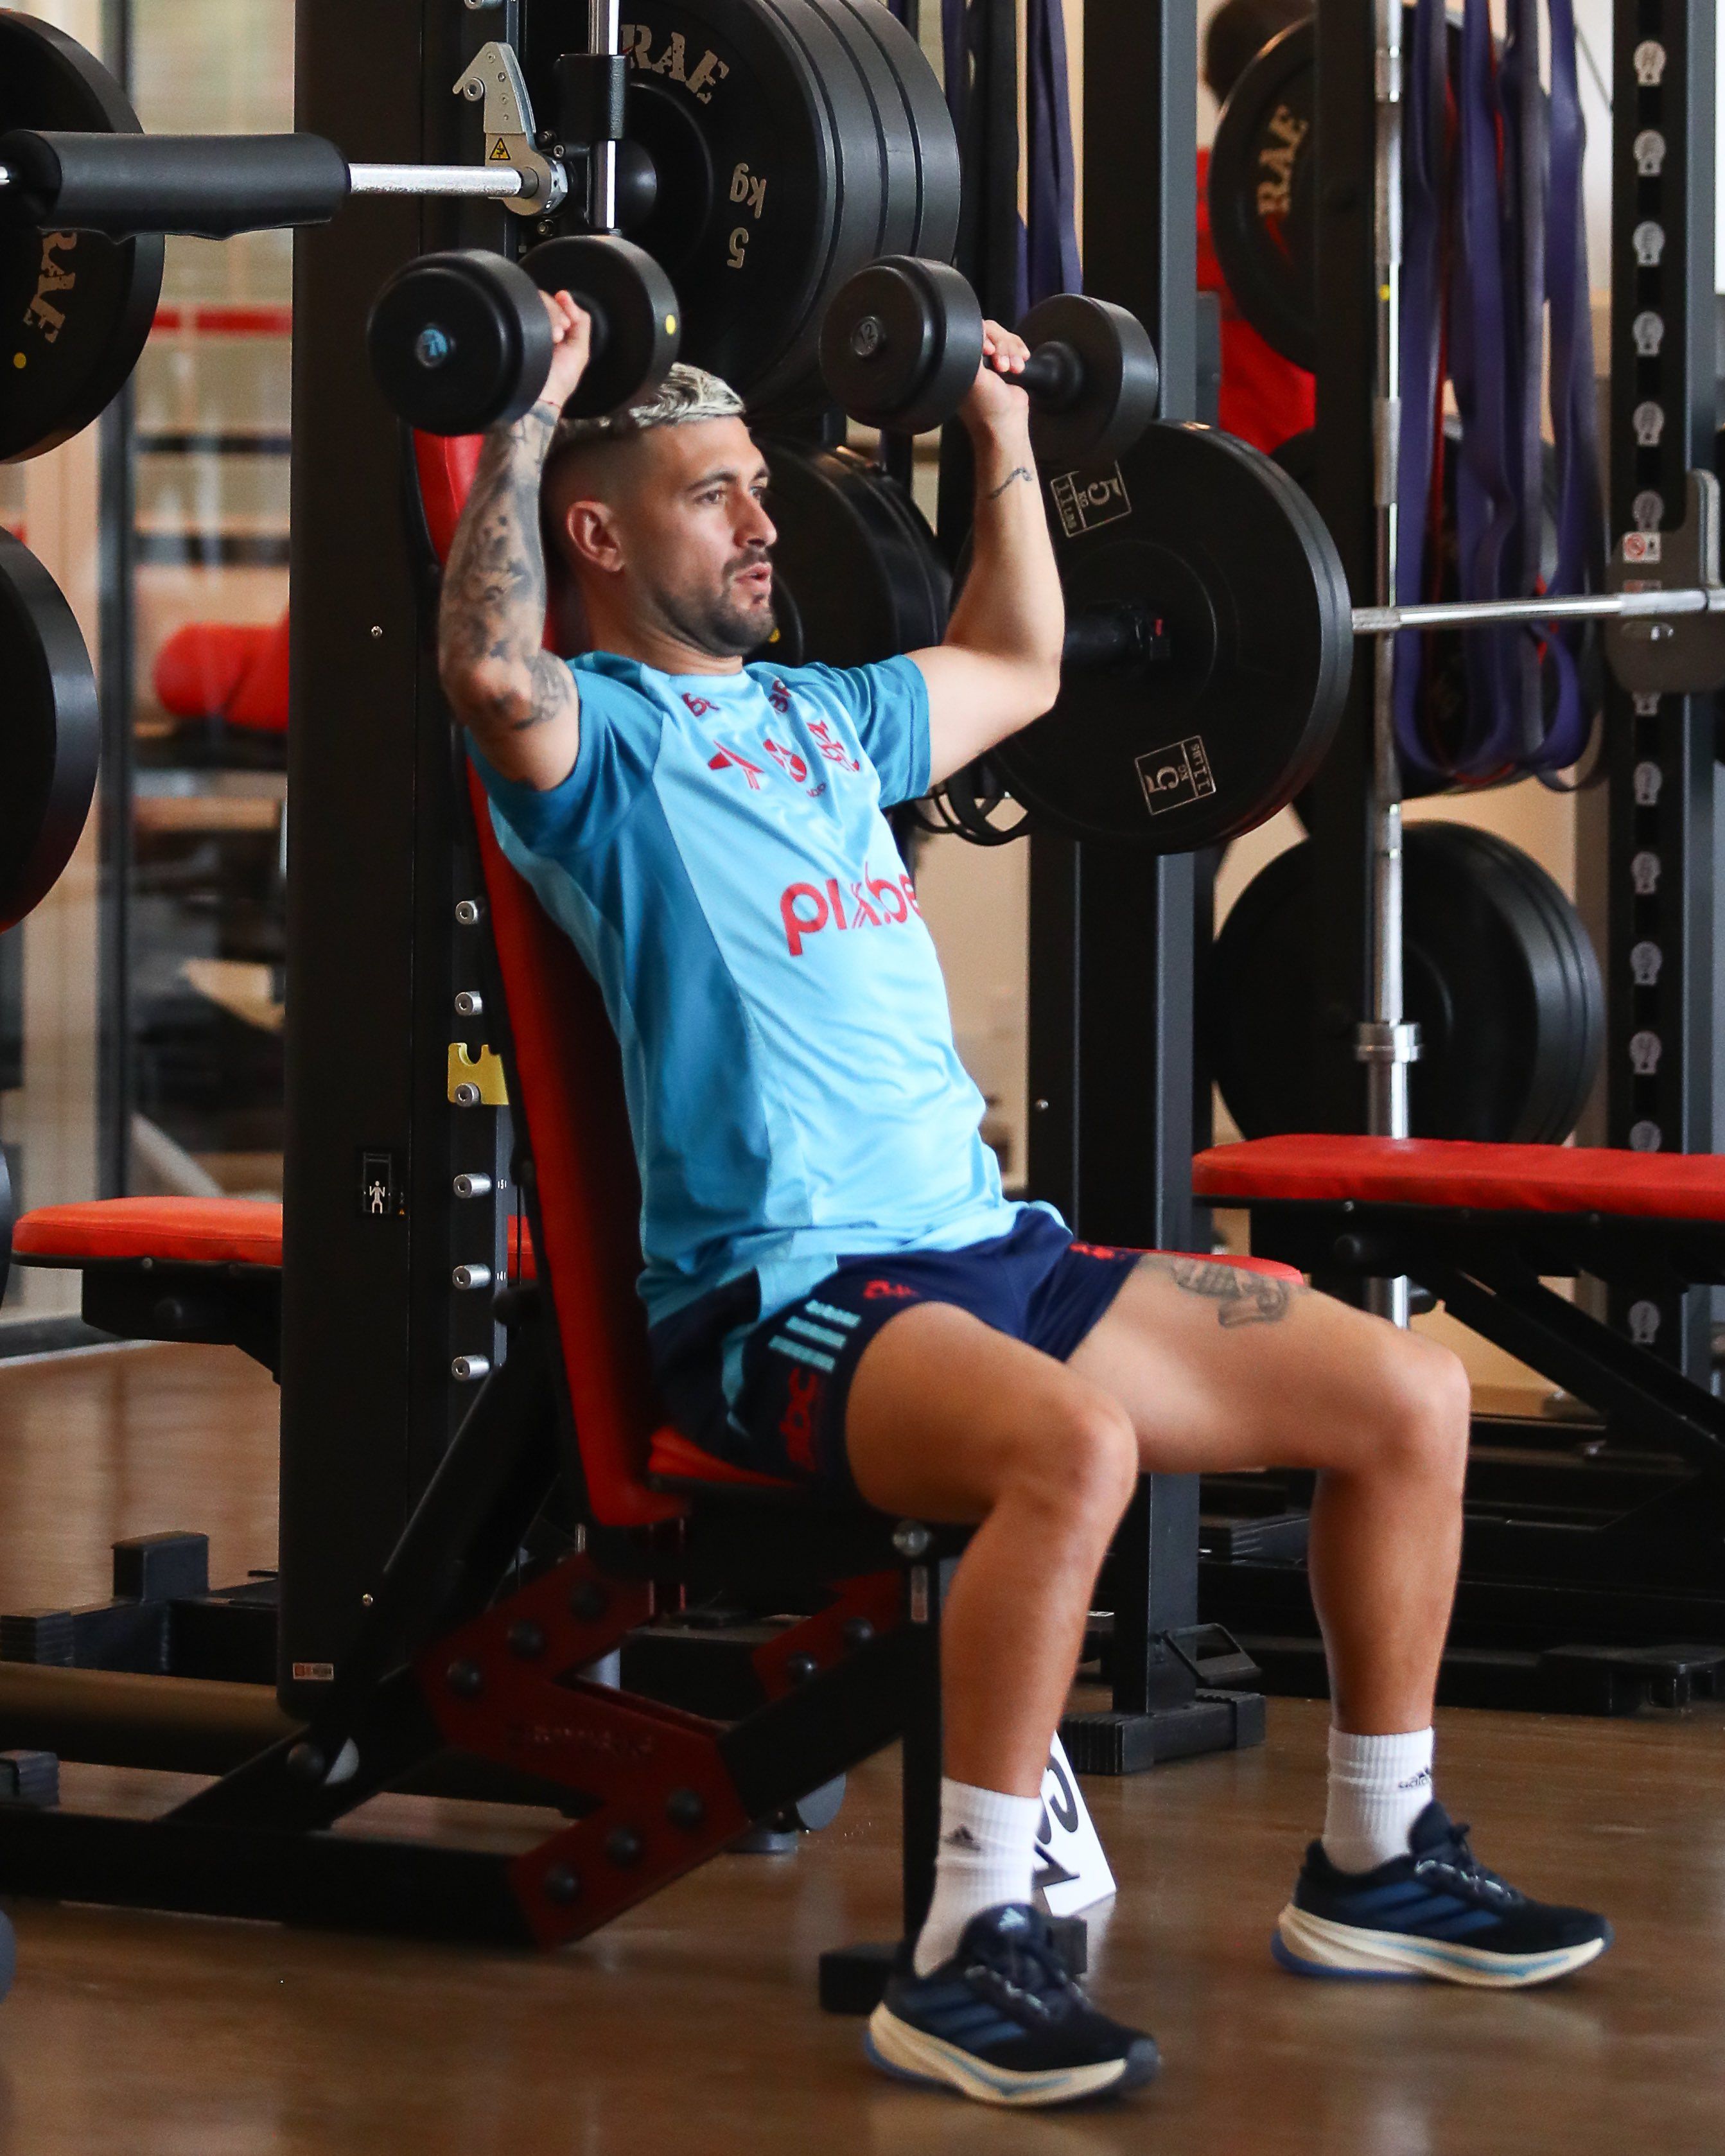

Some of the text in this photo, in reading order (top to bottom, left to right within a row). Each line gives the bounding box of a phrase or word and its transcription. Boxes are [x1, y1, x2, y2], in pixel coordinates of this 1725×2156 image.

[1257, 104, 1308, 216] RAE
[730, 162, 767, 219] kg
[727, 227, 749, 268] 5
[1088, 479, 1123, 506] 5
[1143, 766, 1179, 793] 5
